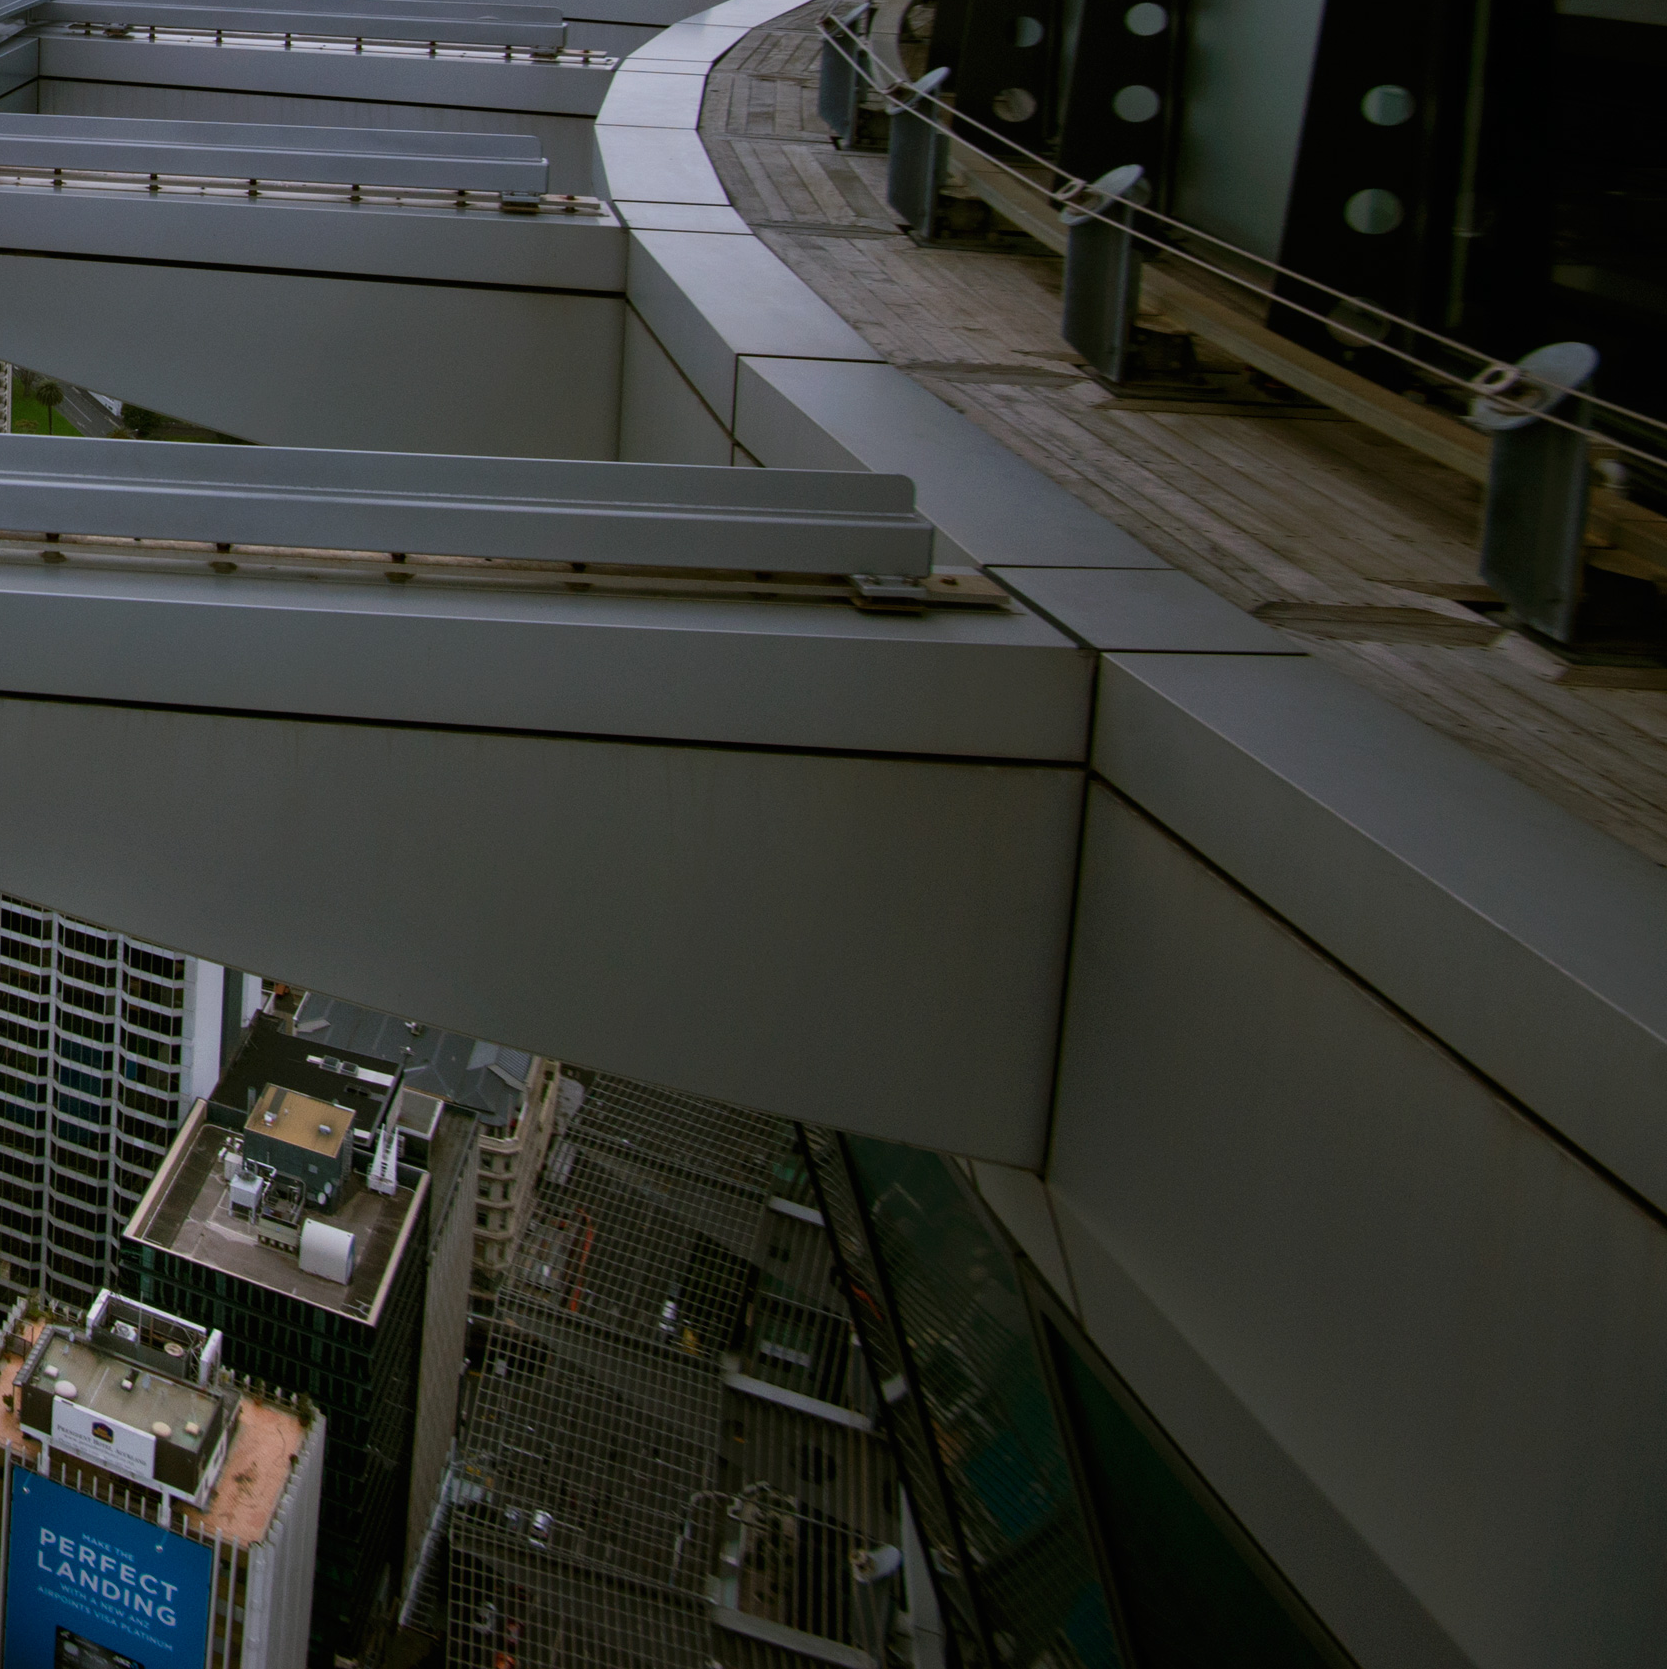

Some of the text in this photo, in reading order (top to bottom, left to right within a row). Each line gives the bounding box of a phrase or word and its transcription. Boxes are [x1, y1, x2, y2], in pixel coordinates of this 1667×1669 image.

[40, 1526, 178, 1602] PERFECT
[82, 1533, 135, 1562] MAKE THE
[37, 1585, 91, 1615] AIRPOINTS
[94, 1610, 117, 1628] VISA
[121, 1622, 173, 1652] PLATINUM
[38, 1549, 177, 1626] LANDING
[60, 1583, 150, 1630] WITH A NEW ANZ
